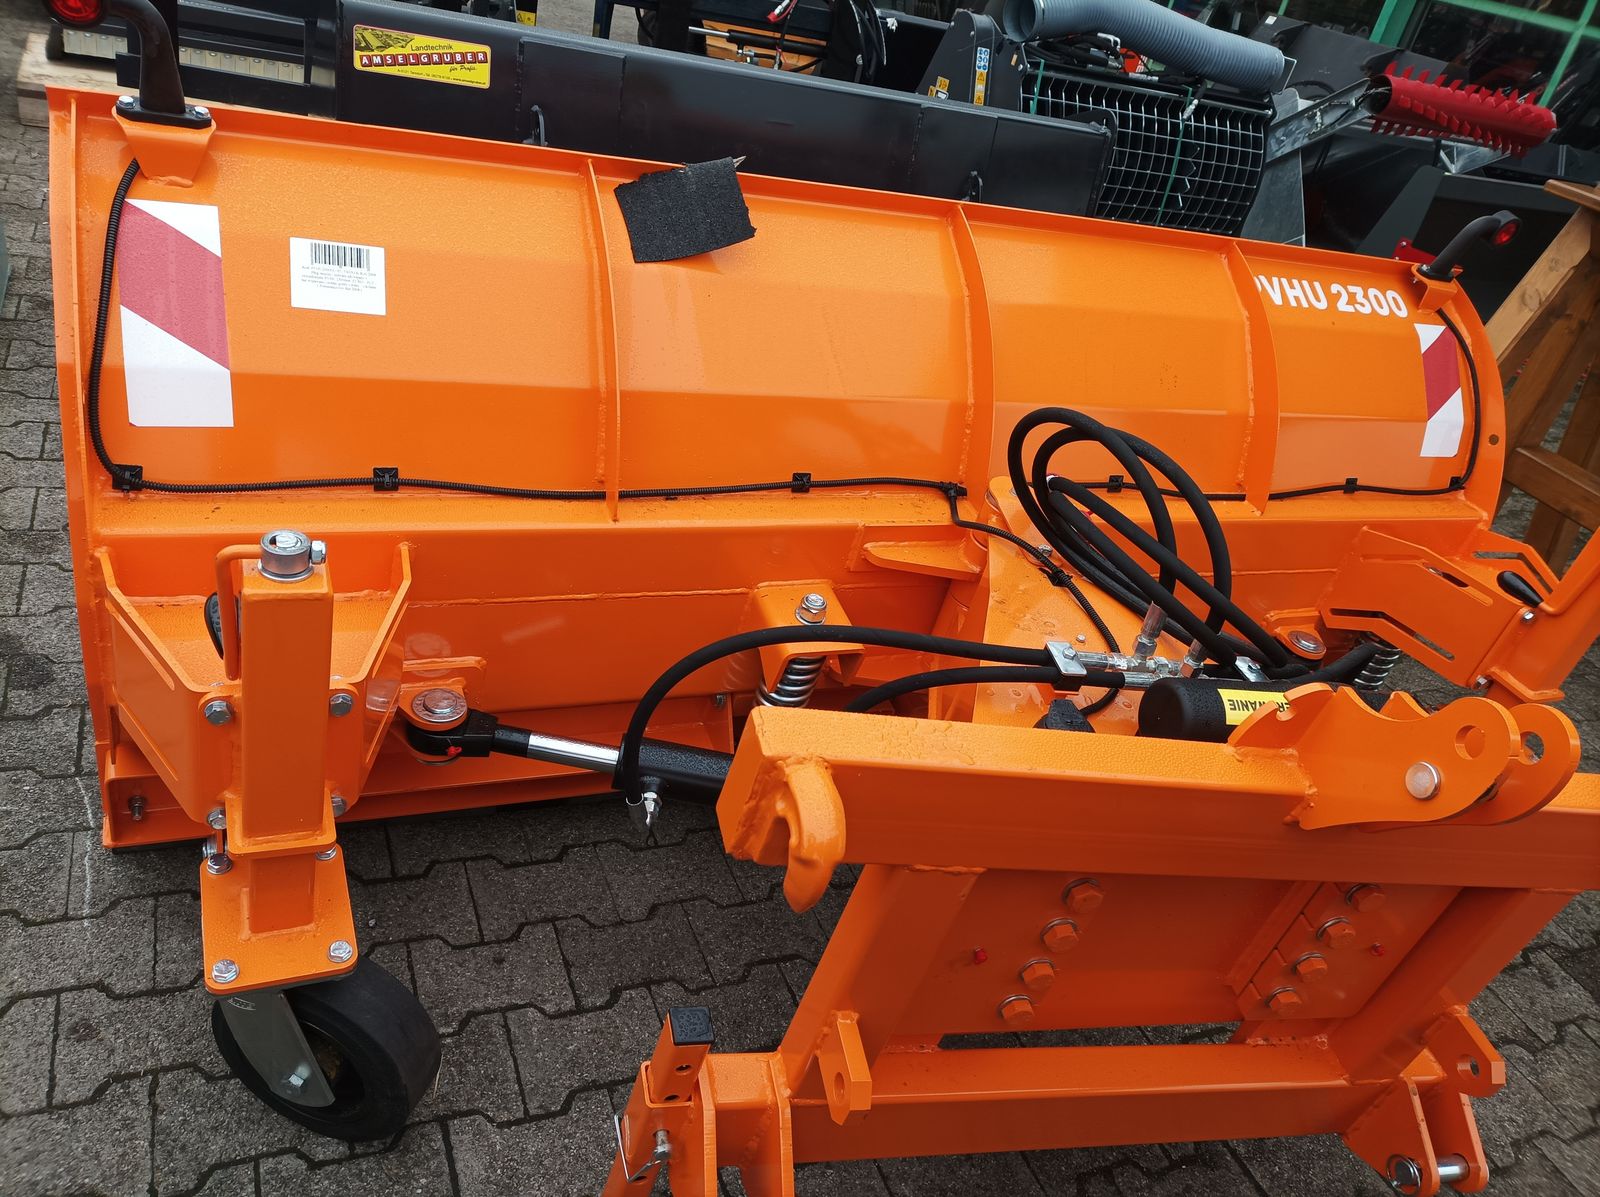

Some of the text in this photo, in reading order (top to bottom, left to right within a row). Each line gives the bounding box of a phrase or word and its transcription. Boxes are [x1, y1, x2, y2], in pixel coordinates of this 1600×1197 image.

[410, 43, 454, 52] Landtechnik
[361, 52, 487, 66] AMSELGRUBER
[1253, 274, 1408, 318] VHU 2300
